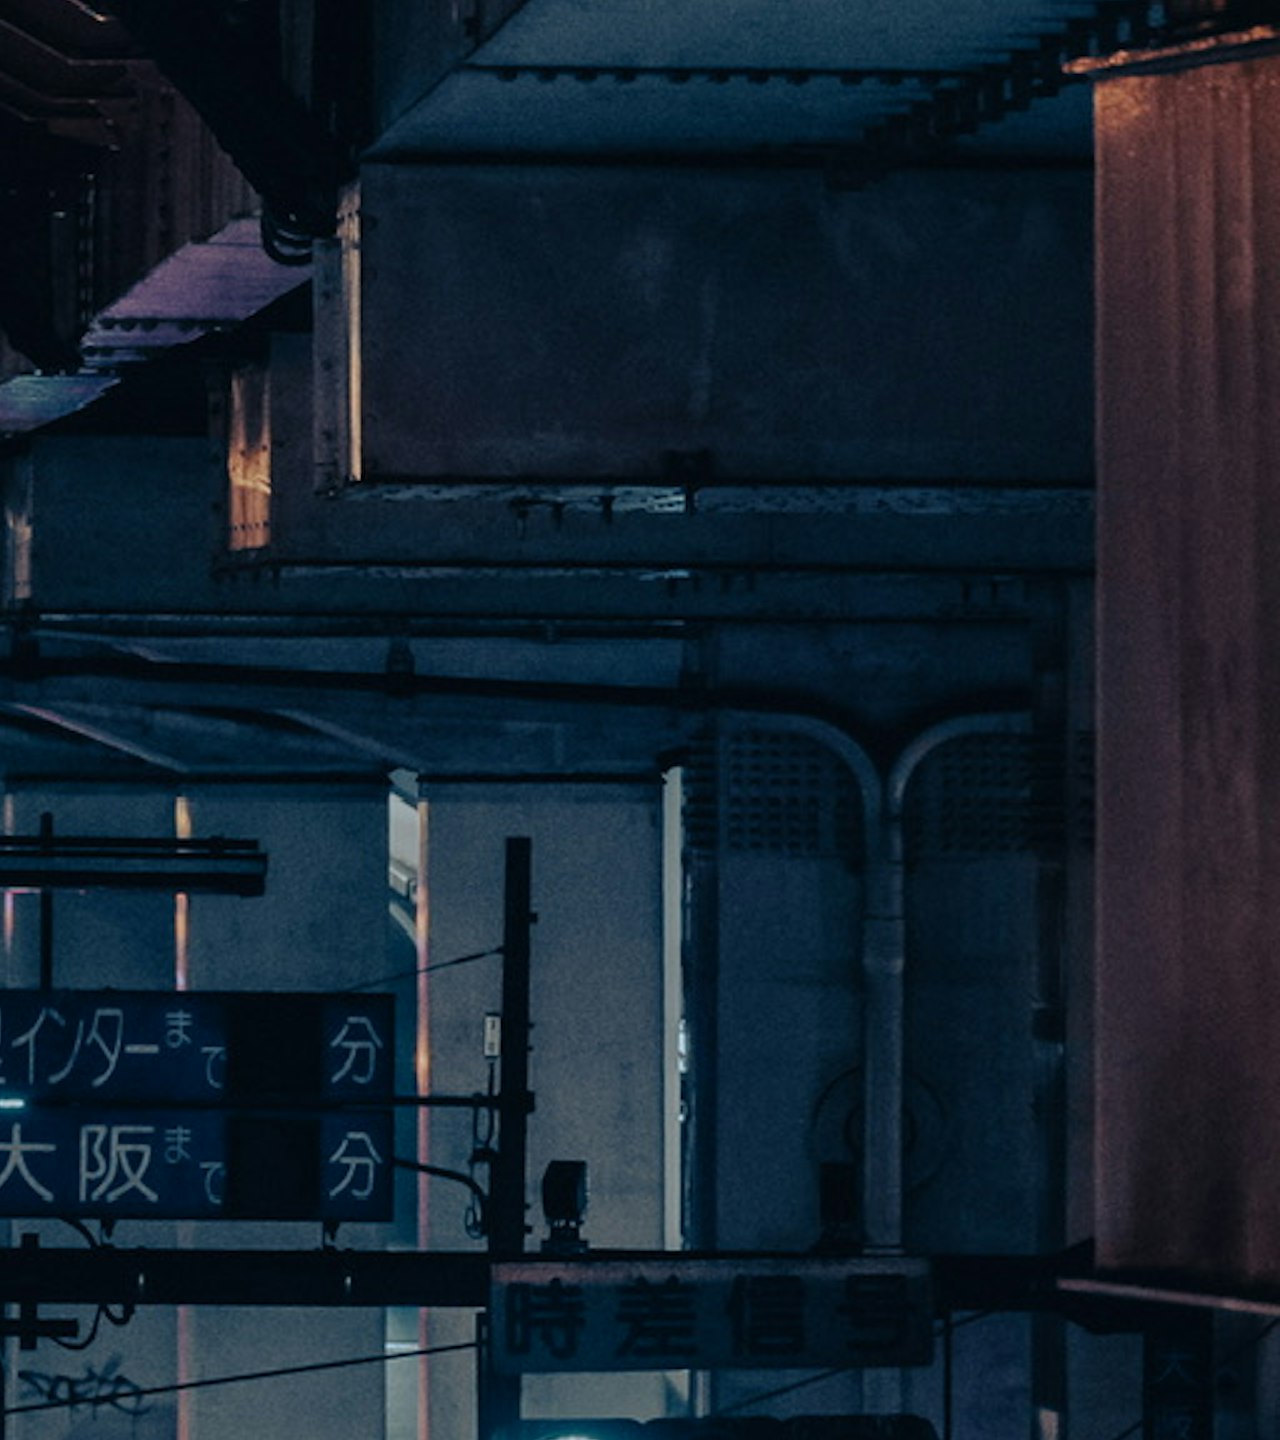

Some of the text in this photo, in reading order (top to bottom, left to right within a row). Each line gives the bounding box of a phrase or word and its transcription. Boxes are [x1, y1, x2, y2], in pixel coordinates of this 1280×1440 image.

[330, 1015, 383, 1086] 分
[328, 1131, 383, 1200] 分
[504, 1274, 920, 1362] 時差信号
